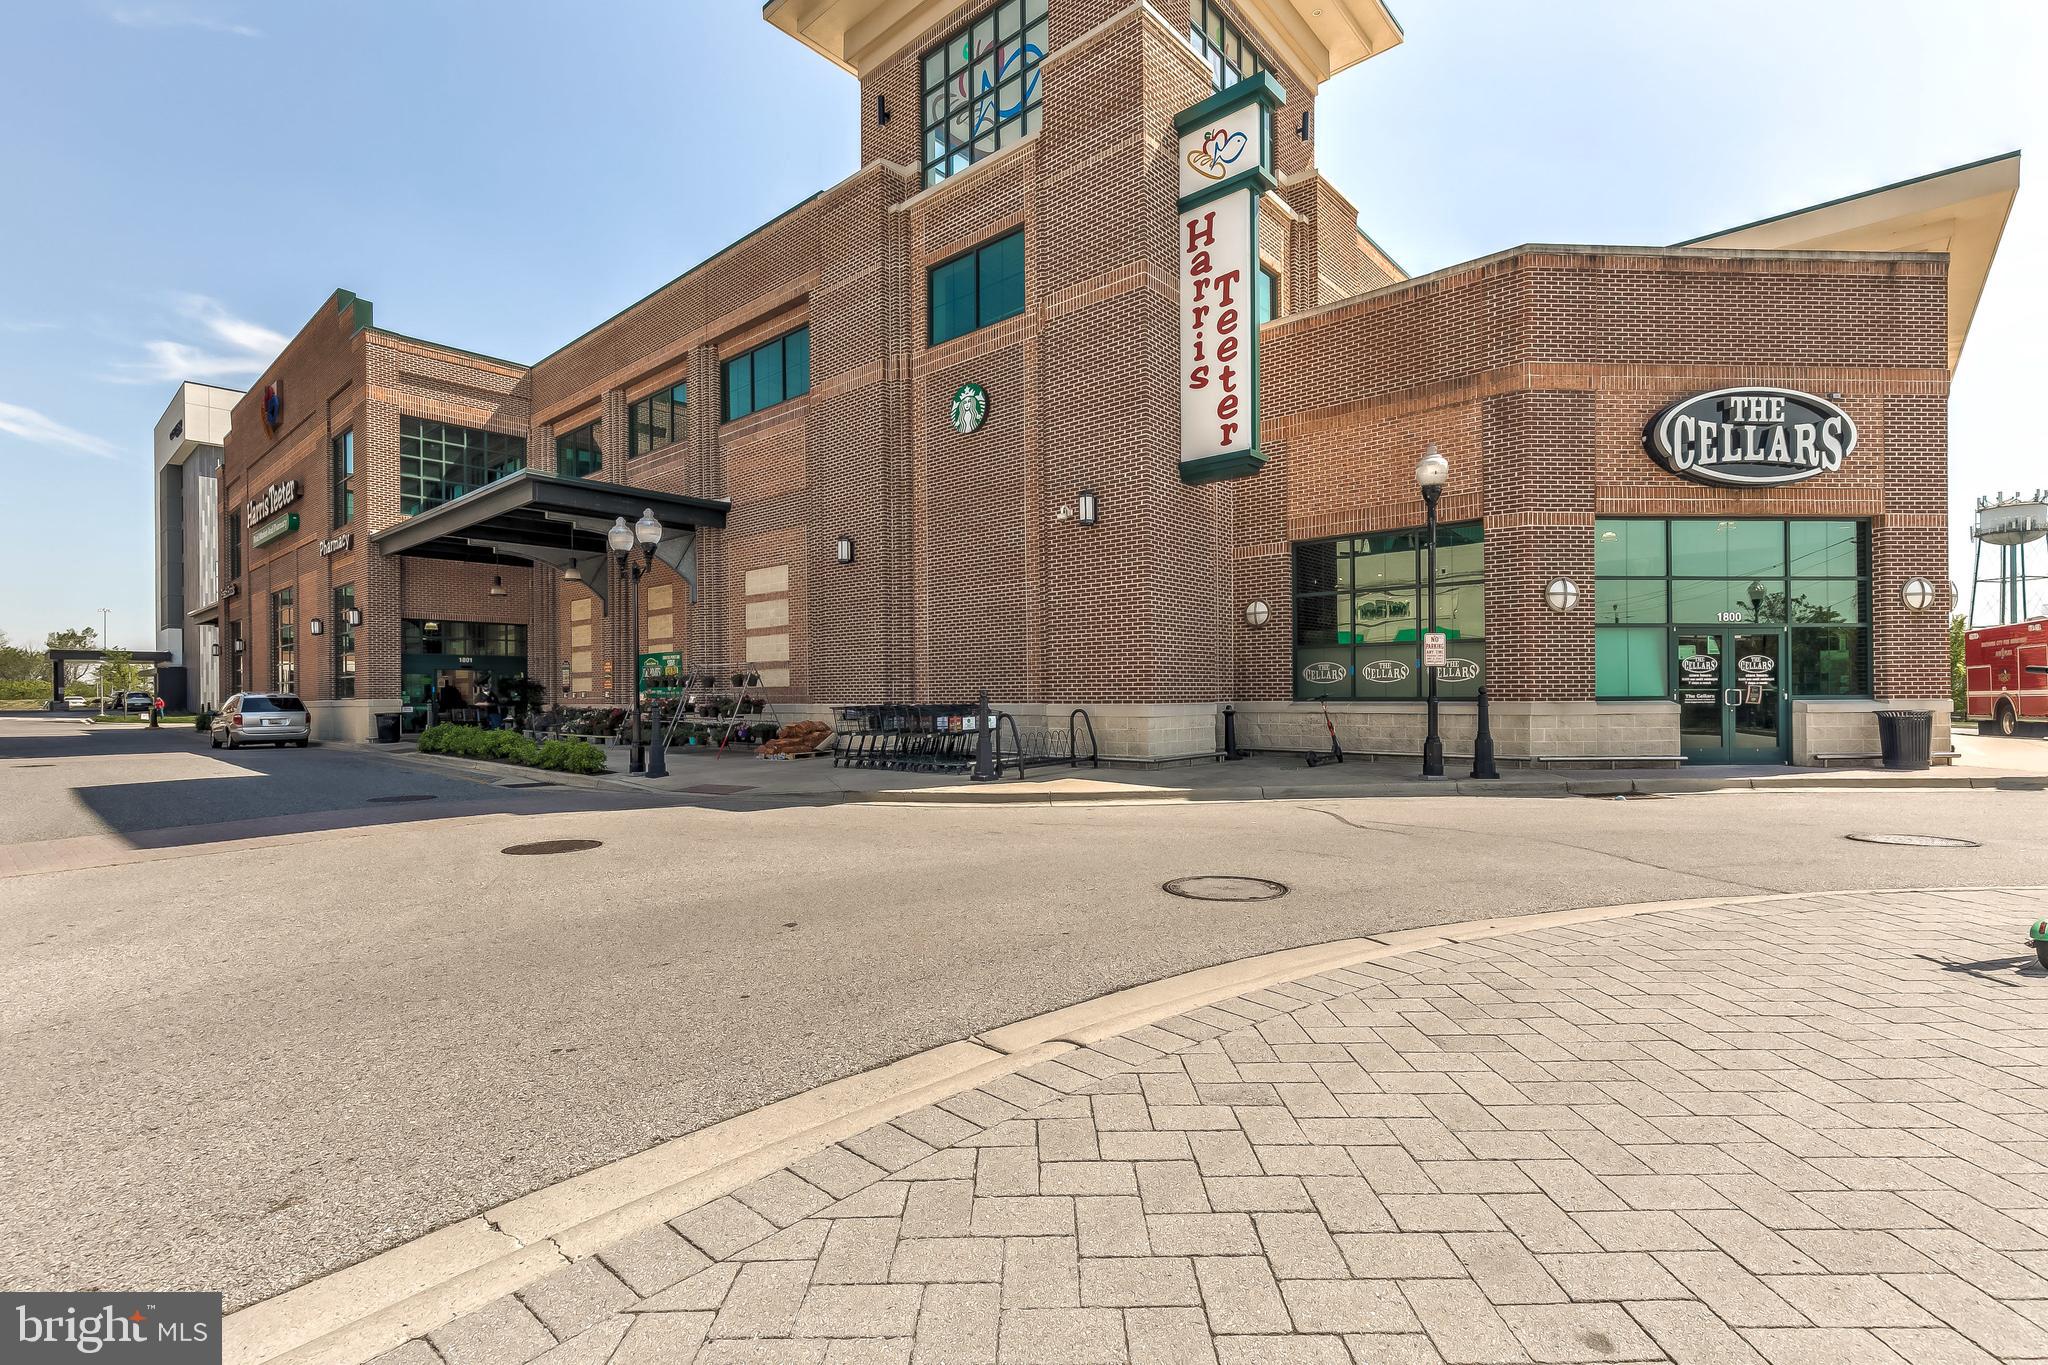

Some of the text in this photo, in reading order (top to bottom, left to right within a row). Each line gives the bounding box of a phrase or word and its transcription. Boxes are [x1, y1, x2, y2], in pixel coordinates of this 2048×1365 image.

[1186, 211, 1215, 390] Harris
[1213, 268, 1240, 447] Teeter
[1730, 396, 1785, 422] THE
[1673, 414, 1843, 473] CELLARS
[247, 480, 295, 529] Harris Teeter
[319, 533, 350, 557] Pharmacy
[1717, 612, 1742, 622] 1800
[1437, 664, 1477, 679] ELLARS
[1446, 660, 1460, 668] THE
[1684, 660, 1715, 671] CELLARS
[1740, 660, 1772, 671] CELLARS
[1305, 668, 1344, 681] CELLARS
[1365, 666, 1406, 680] CELLARS
